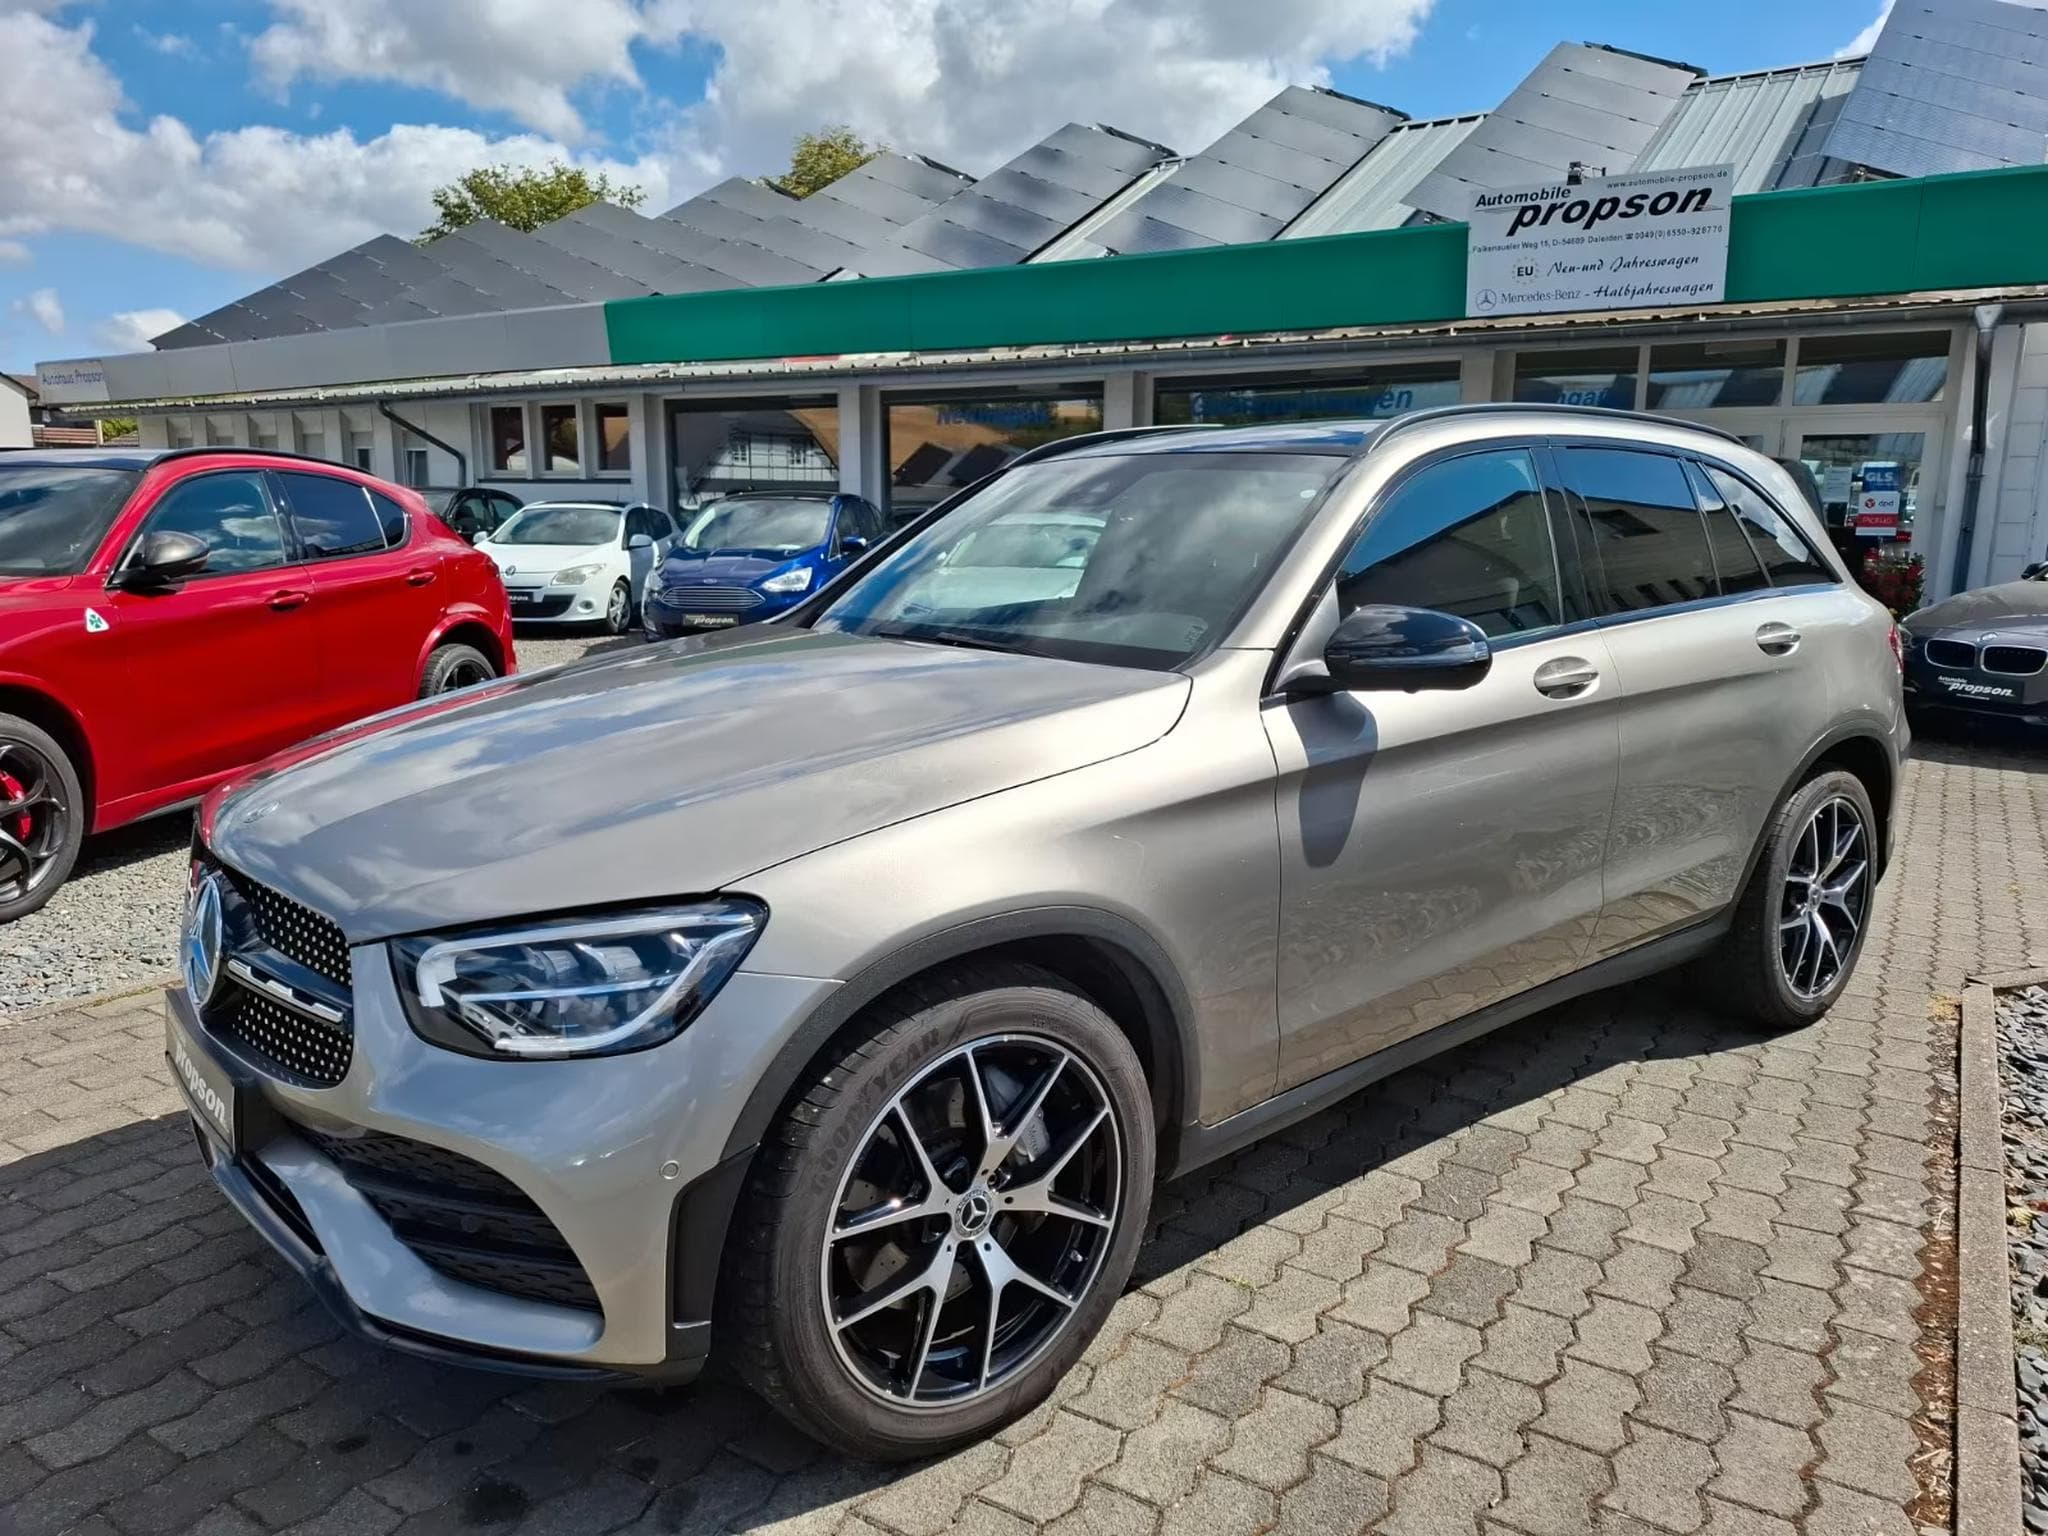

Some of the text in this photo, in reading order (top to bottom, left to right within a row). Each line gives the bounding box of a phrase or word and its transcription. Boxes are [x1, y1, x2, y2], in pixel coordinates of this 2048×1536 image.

[1607, 170, 1728, 189] www.automobile-propson.de
[1475, 187, 1572, 208] Automobile
[1506, 187, 1713, 237] propson
[1521, 241, 1539, 250] Weg
[1516, 266, 1535, 278] EU
[1609, 255, 1700, 273] Jahreswagen
[1501, 289, 1582, 305] Mercedes-Benz
[1593, 281, 1714, 300] Halbjahreswagen
[1866, 472, 1894, 482] GLS
[1948, 682, 2013, 696] propson
[176, 1041, 226, 1125] propson
